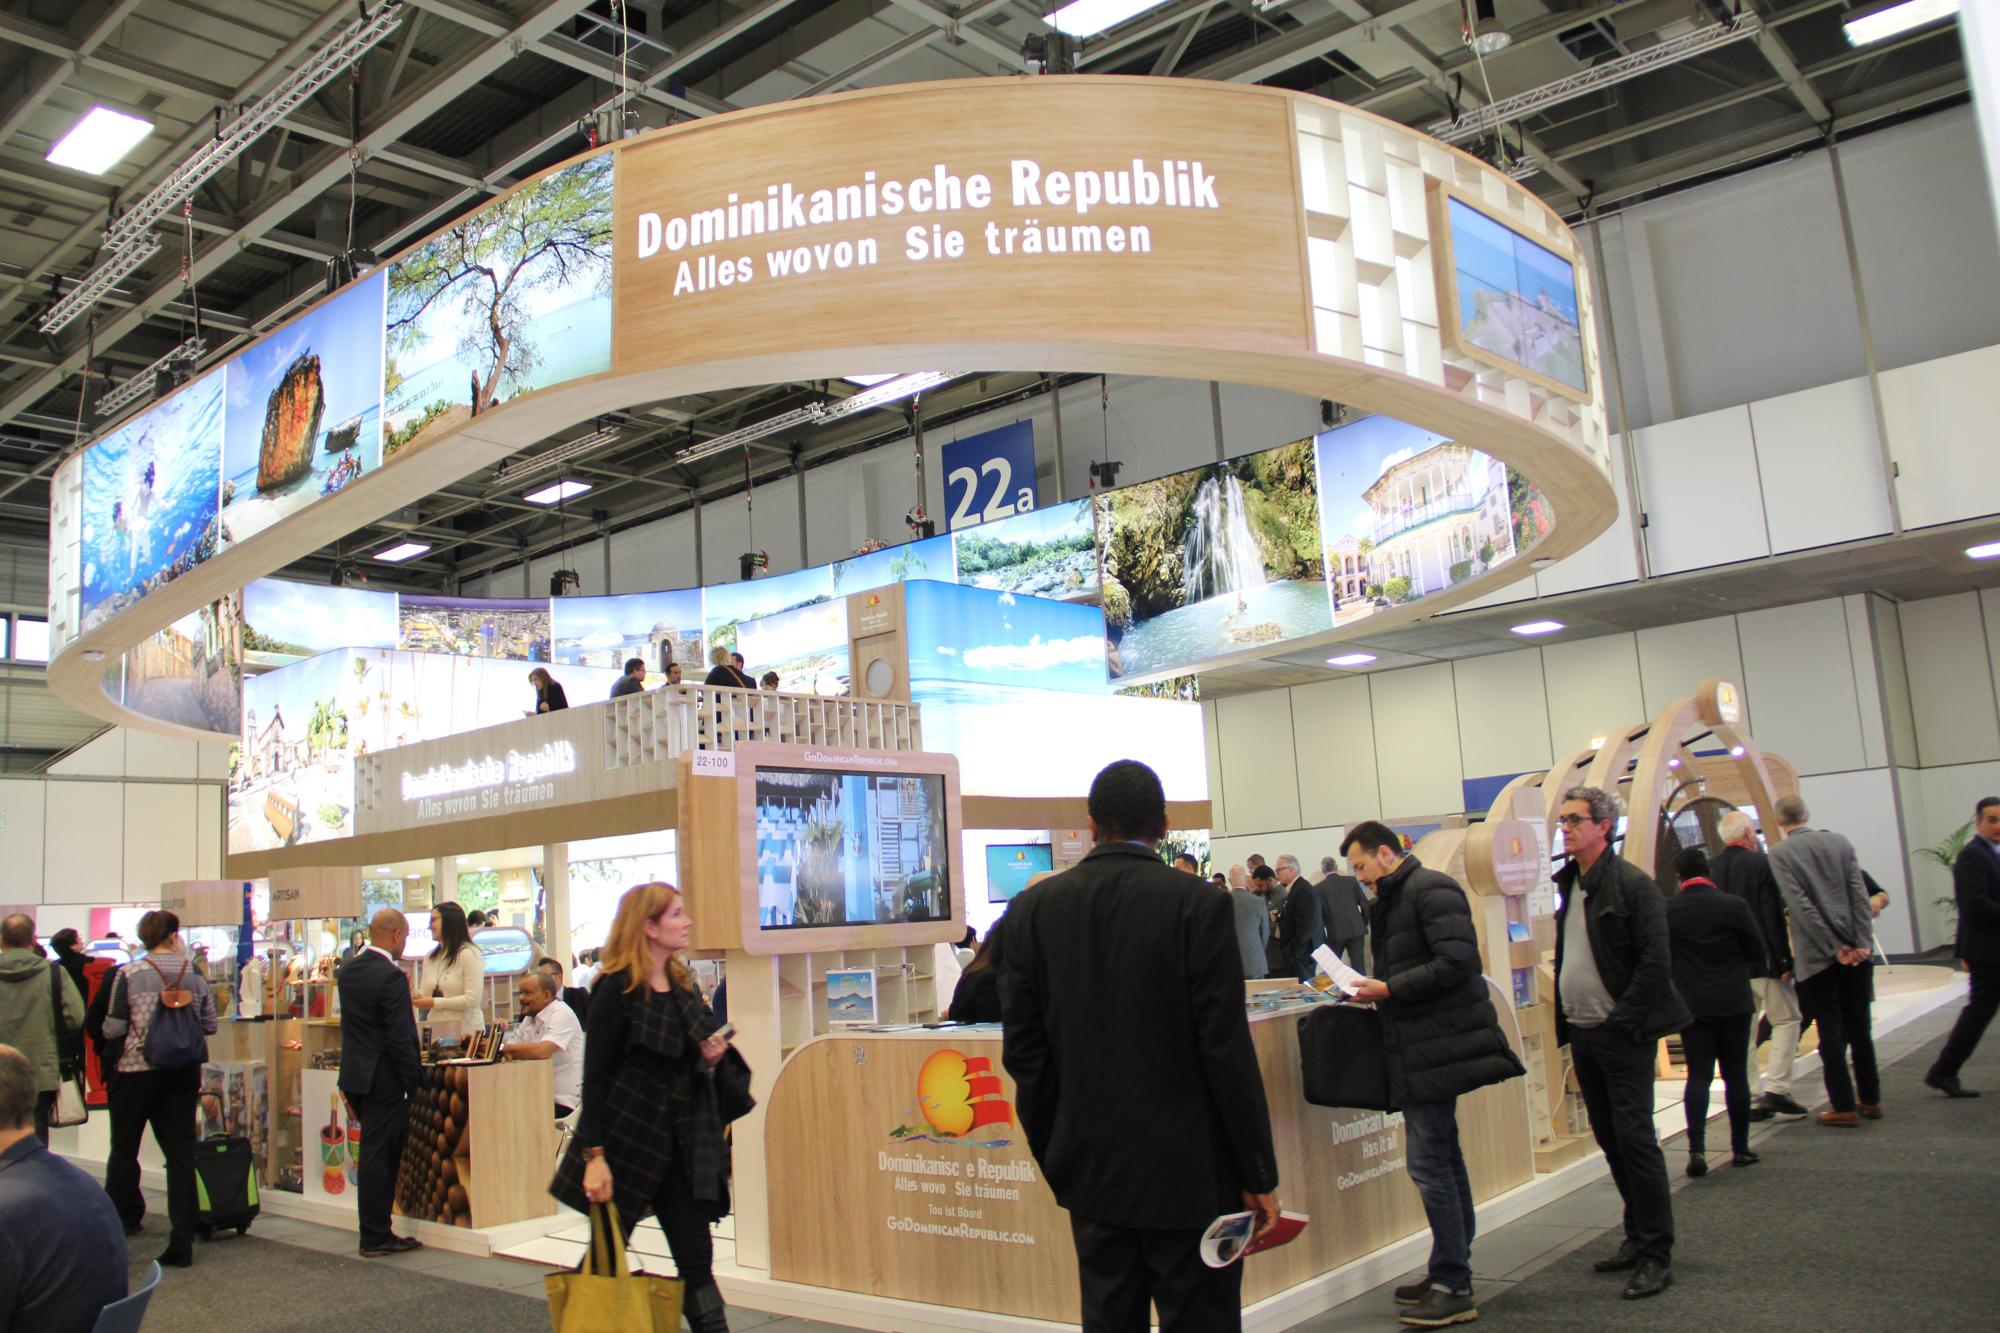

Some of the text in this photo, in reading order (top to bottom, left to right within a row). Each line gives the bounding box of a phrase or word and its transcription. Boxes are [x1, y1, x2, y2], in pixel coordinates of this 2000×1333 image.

[638, 158, 1219, 258] Dominikanische Republik
[673, 219, 1151, 296] Alles wovon Sie träumen
[948, 457, 1034, 530] 22a
[696, 755, 728, 768] 22-100
[417, 783, 555, 819] Alles wovon Sie träumen
[272, 888, 300, 901] ARTISAN
[1331, 1112, 1383, 1146] Dominican
[1362, 1131, 1399, 1160] Has it all
[977, 1157, 1037, 1184] Republik
[894, 1176, 918, 1192] Alles
[954, 1181, 972, 1197] Sie
[974, 1183, 1020, 1201] träumen
[957, 1207, 983, 1219] Board
